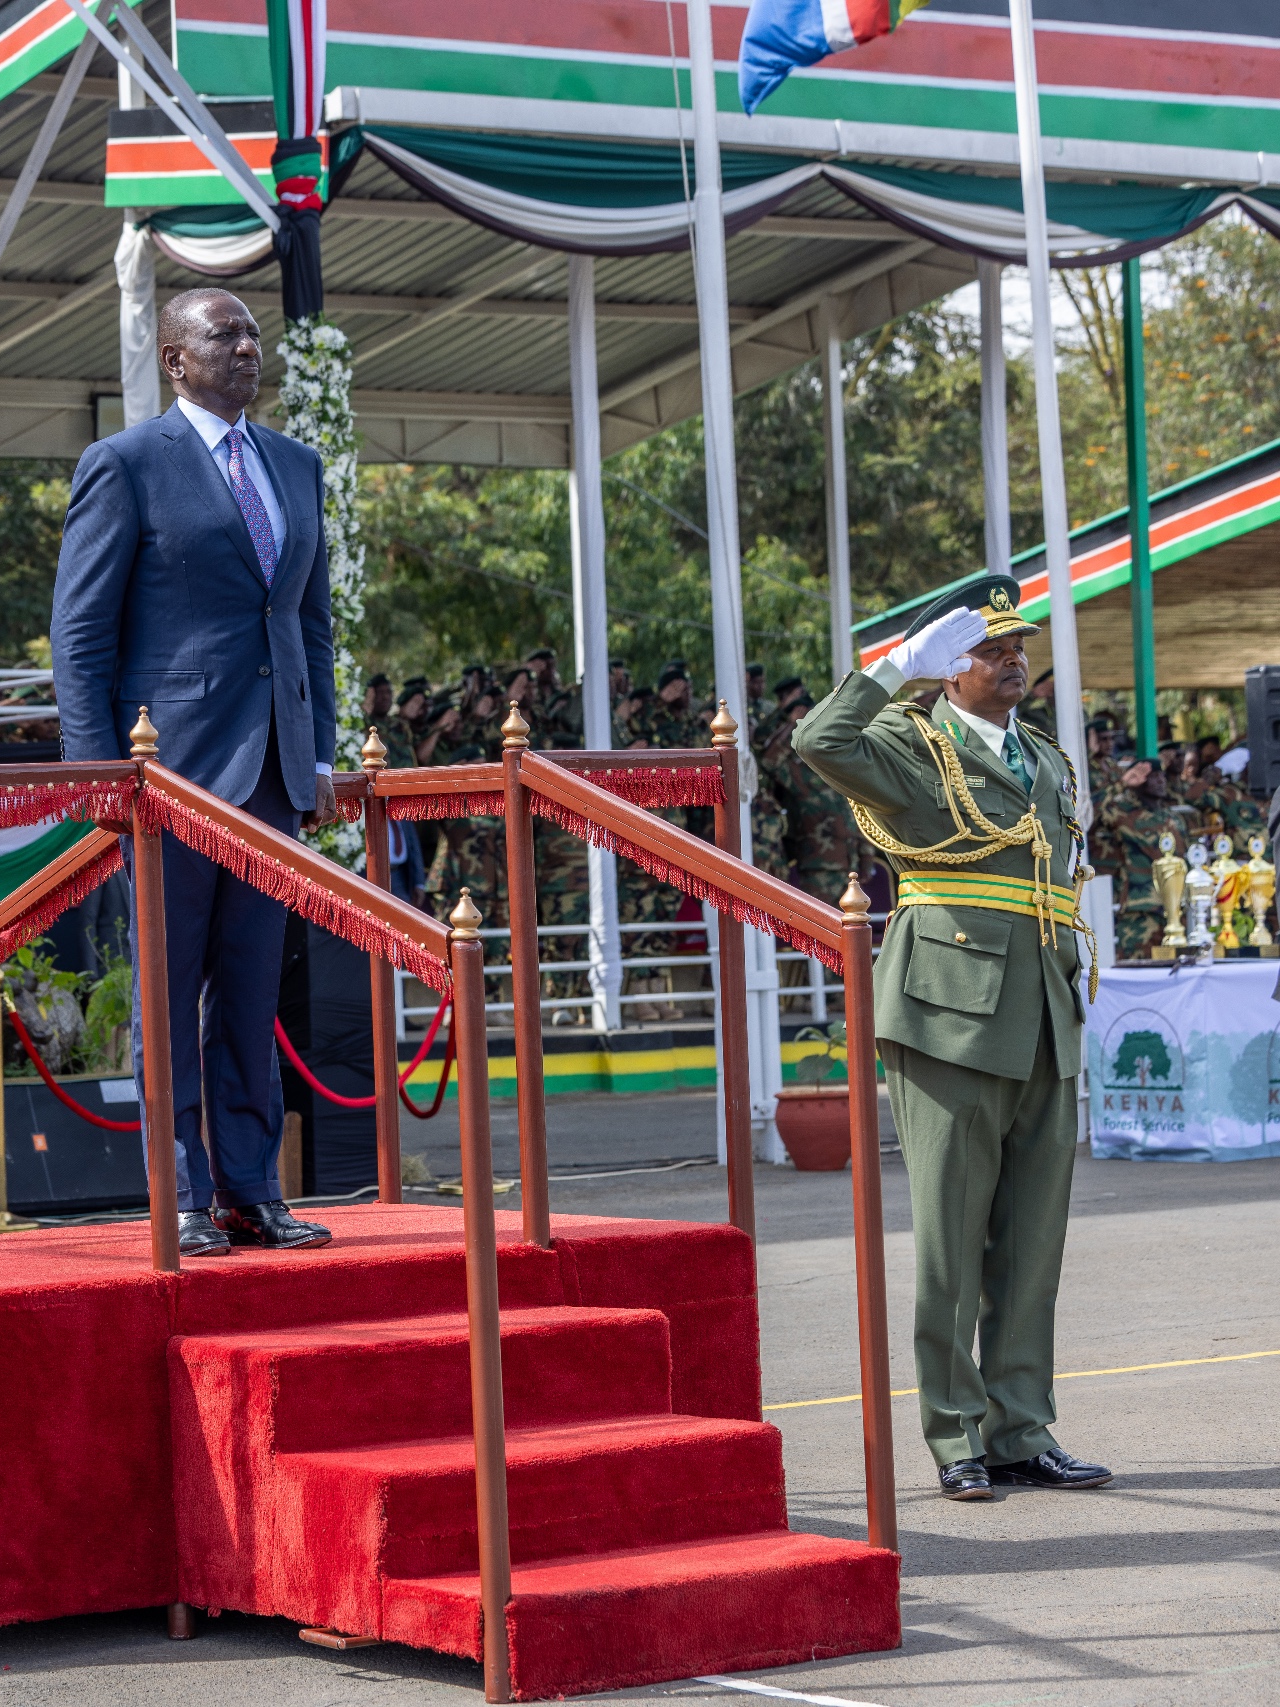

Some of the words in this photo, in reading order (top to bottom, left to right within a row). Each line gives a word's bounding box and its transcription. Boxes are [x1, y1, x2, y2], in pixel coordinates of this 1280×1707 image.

[1103, 1094, 1184, 1112] KENYA
[1103, 1117, 1138, 1130] Forest
[1142, 1118, 1185, 1132] Service
